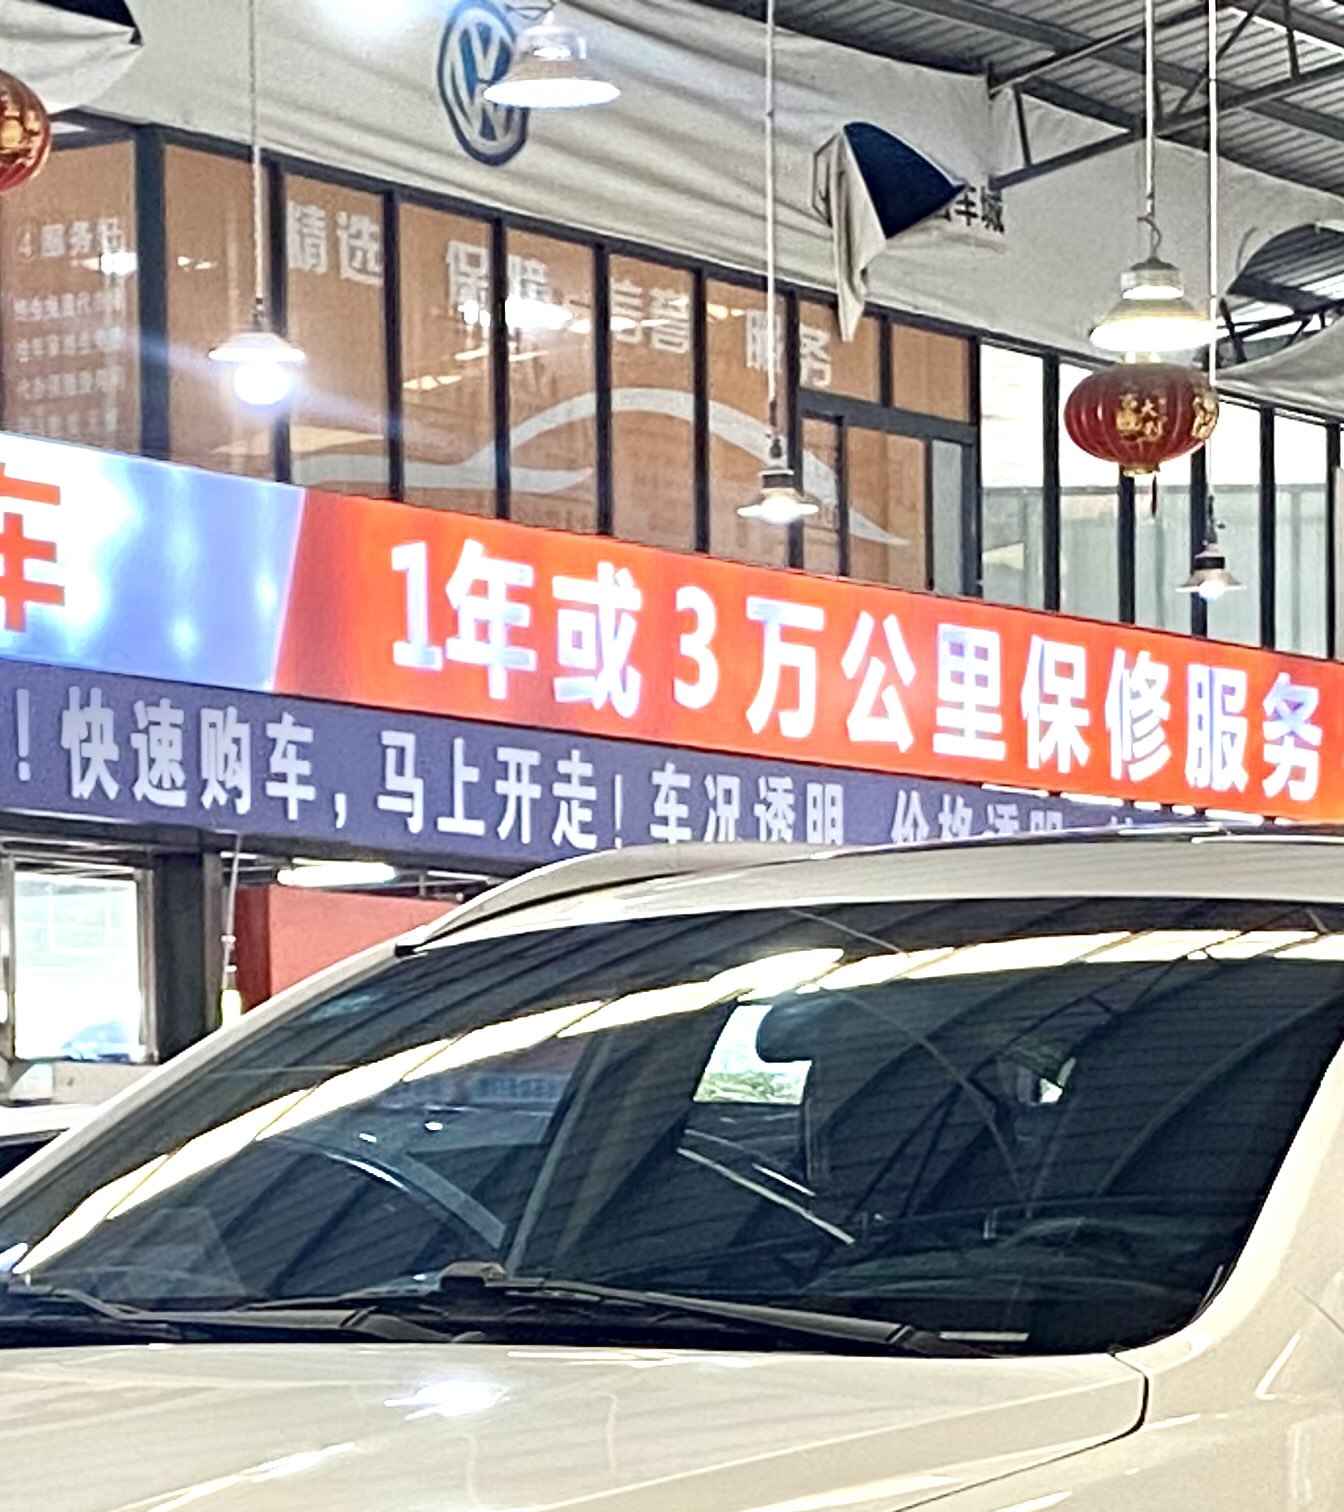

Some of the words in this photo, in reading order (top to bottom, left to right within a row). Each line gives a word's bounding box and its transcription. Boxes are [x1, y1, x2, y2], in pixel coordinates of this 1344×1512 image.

[391, 539, 1323, 802] 1年或3万公里保修服务
